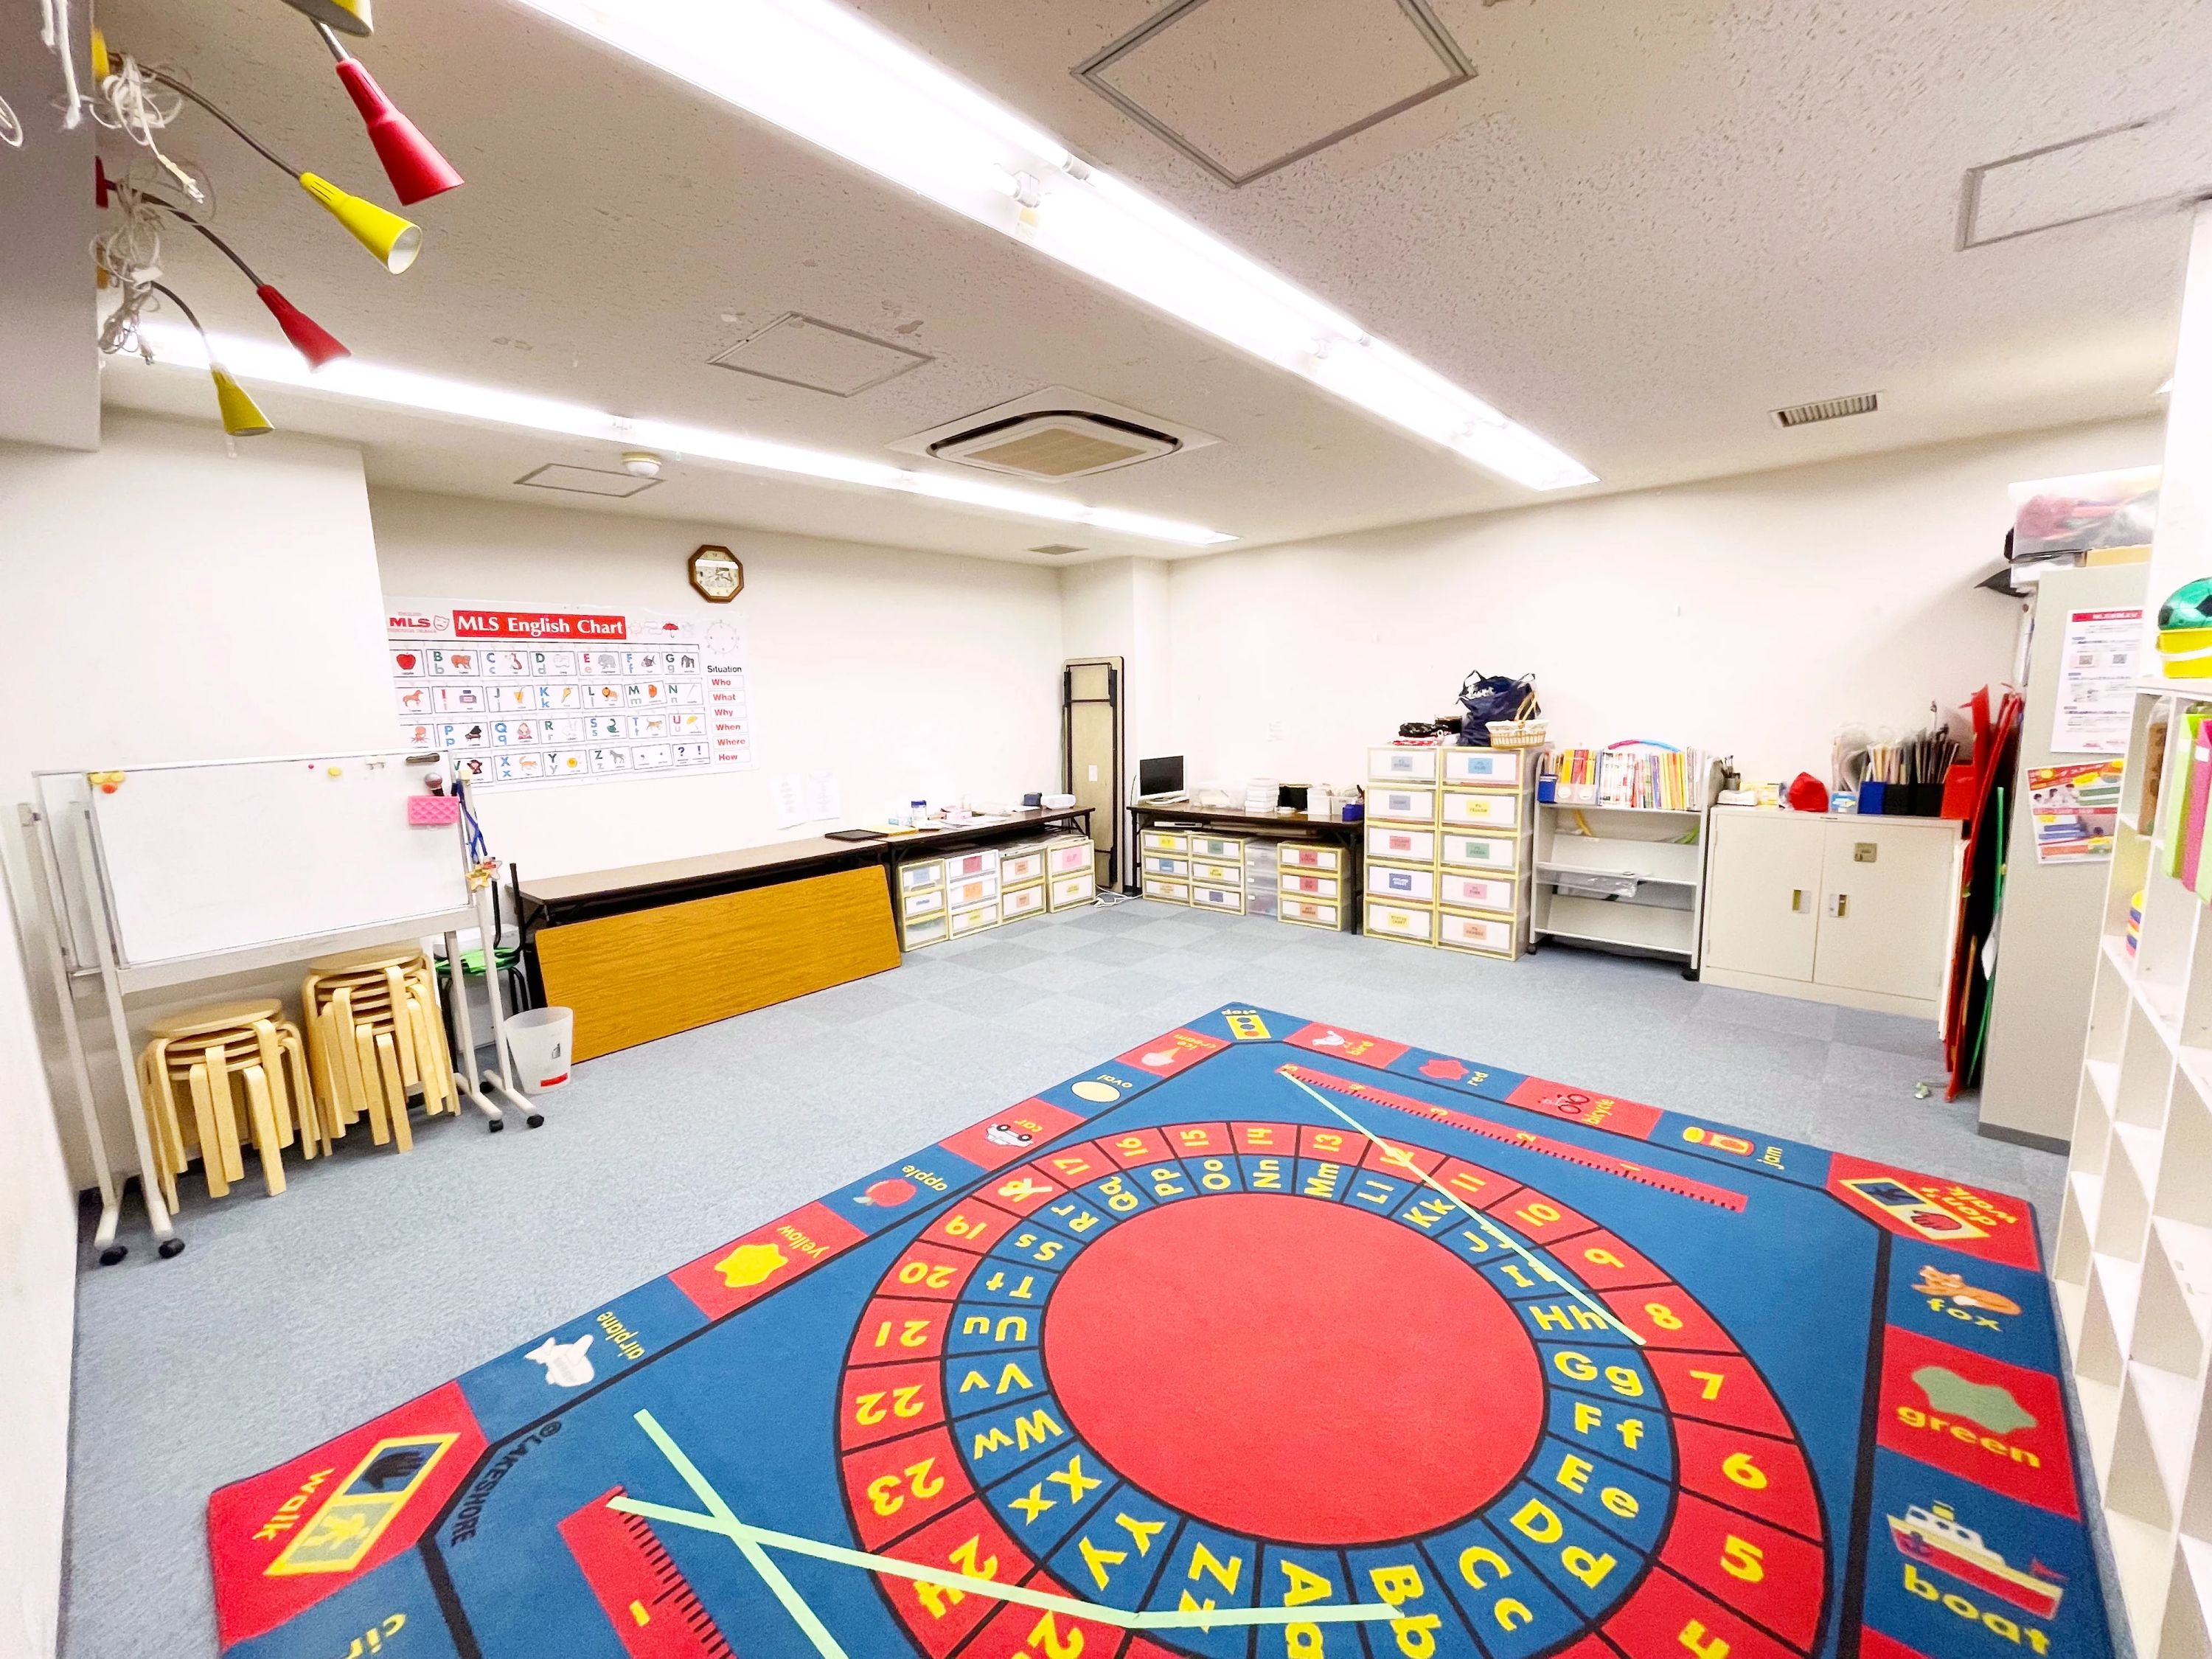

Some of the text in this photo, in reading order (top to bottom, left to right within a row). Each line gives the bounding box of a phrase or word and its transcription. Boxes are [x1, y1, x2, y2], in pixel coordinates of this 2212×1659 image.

[389, 617, 431, 627] MLS
[458, 616, 623, 637] MLS English Chart
[433, 651, 443, 661] B
[486, 653, 495, 663] C
[535, 653, 546, 663] D
[583, 653, 591, 663] E
[626, 653, 633, 663] F
[665, 654, 675, 663] G
[434, 663, 445, 675] b
[538, 664, 546, 674] d
[628, 664, 634, 674] f
[667, 664, 675, 674] g
[494, 688, 501, 698] J
[539, 686, 550, 698] K
[588, 686, 595, 696] L
[628, 685, 640, 695] M
[668, 684, 678, 694] N
[541, 698, 550, 708] k
[714, 709, 733, 717] Why
[545, 720, 553, 730] R
[590, 718, 598, 728] S
[632, 717, 639, 726] T
[673, 716, 681, 724] U
[445, 725, 454, 736] P
[495, 723, 507, 733] Q
[634, 728, 639, 736] t
[445, 738, 456, 747] p
[498, 735, 507, 745] q
[548, 753, 557, 763] Y
[594, 750, 603, 759] Z
[501, 757, 510, 767] X
[549, 765, 558, 774] y
[1173, 1034, 1217, 1049] cream
[1177, 1040, 1198, 1050] ice
[1346, 1040, 1374, 1056] bird
[1096, 1074, 1133, 1088] oval
[1467, 1071, 1489, 1085] red
[1430, 1107, 1449, 1116] 3
[1582, 1098, 1615, 1127] bicycle
[1014, 1119, 1043, 1133] car
[1180, 1129, 1210, 1147] 15
[1247, 1127, 1273, 1146] 14
[1313, 1133, 1343, 1152] 13
[1515, 1132, 1537, 1142] 2
[1116, 1136, 1149, 1158] 16
[1756, 1146, 1784, 1169] jam
[1053, 1158, 1090, 1176] 17
[902, 1165, 948, 1192] apple
[1450, 1172, 1486, 1193] 11
[1946, 1186, 2019, 1224] walk
[1515, 1203, 1562, 1228] 10
[944, 1214, 987, 1240] 19
[776, 1225, 830, 1259] yellow
[1583, 1248, 1625, 1269] 9
[898, 1261, 956, 1290] 20
[1644, 1302, 1683, 1331] 8
[1927, 1298, 2003, 1332] fox
[597, 1311, 645, 1360] airplane
[874, 1320, 930, 1349] 21
[1689, 1370, 1725, 1401] 7
[855, 1384, 925, 1427] 22
[1896, 1405, 2040, 1469] green
[1722, 1452, 1768, 1490] 6
[866, 1457, 945, 1517] 23
[252, 1468, 335, 1540] walk
[1720, 1534, 1765, 1583] 5
[1905, 1562, 2051, 1656] boat
